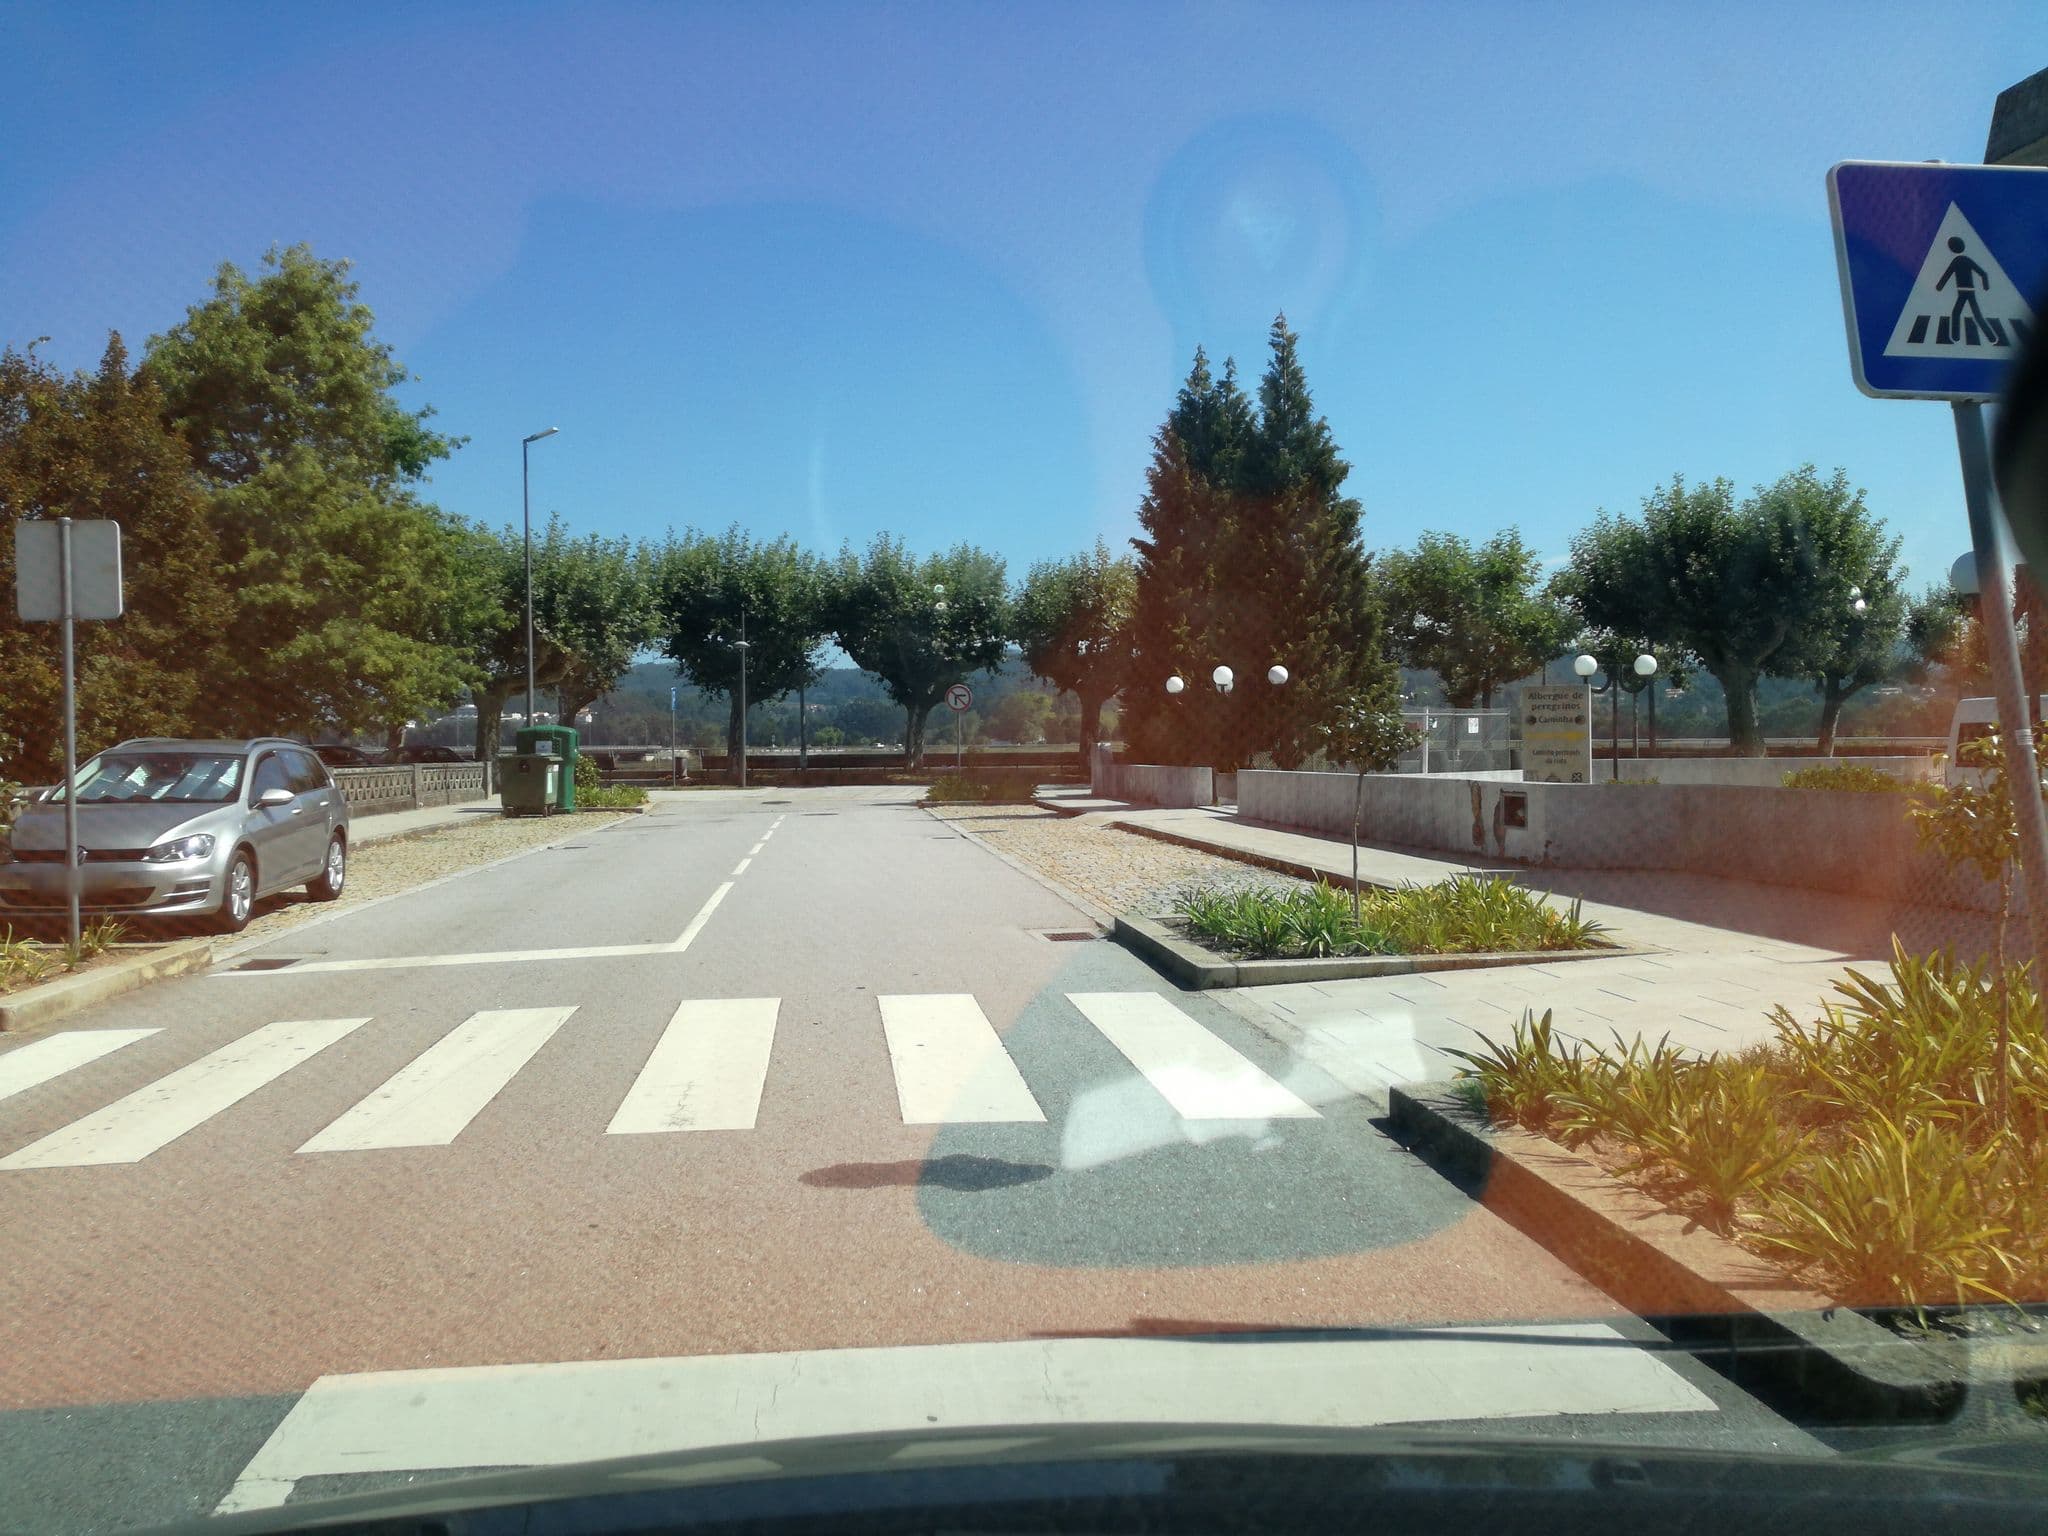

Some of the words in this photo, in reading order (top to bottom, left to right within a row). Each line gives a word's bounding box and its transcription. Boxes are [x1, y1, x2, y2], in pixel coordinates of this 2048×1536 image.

[1528, 691, 1569, 701] Albergue
[1572, 691, 1584, 700] de
[1531, 702, 1581, 711] peregrinos
